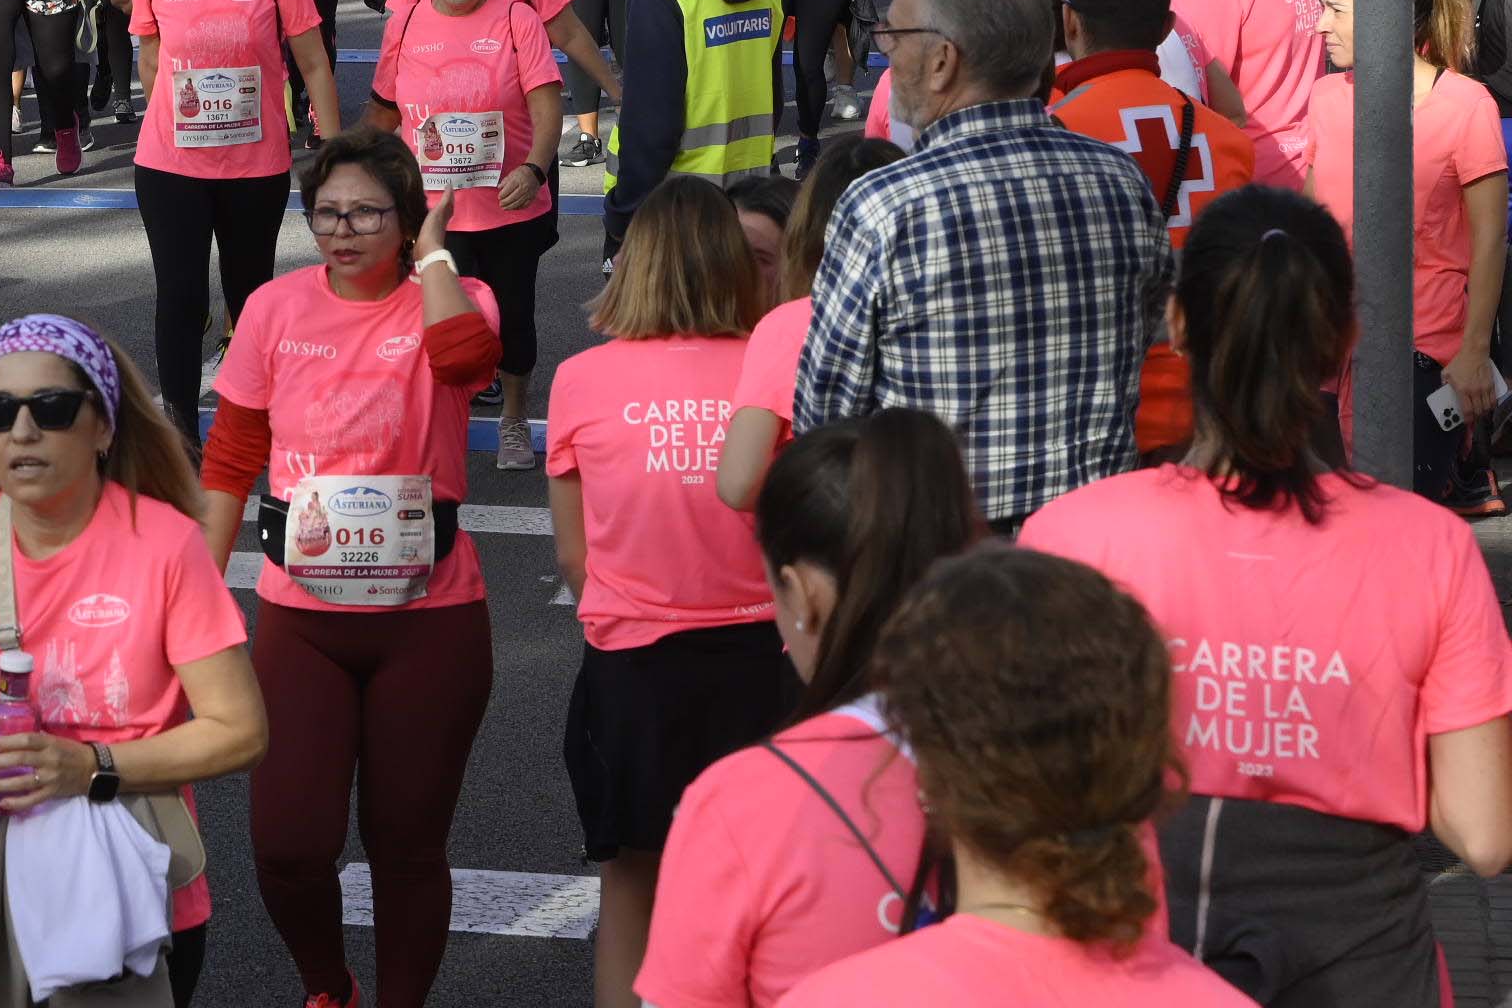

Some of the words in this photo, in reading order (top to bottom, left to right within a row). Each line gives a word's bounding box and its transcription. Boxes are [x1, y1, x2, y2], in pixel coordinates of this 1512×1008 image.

[200, 81, 234, 90] ASTURIANA
[202, 99, 232, 111] 016
[405, 103, 430, 121] TU
[182, 134, 209, 142] OYSHO
[446, 144, 475, 154] 016
[278, 340, 337, 360] OYSHO
[623, 399, 731, 425] CARRER
[650, 423, 684, 448] DE
[696, 423, 726, 446] LA
[646, 447, 720, 473] MUJE
[681, 476, 704, 484] 2023
[397, 493, 423, 501] SUMA
[333, 499, 387, 510] ASTURIANA
[335, 527, 385, 546] 016
[340, 551, 379, 563] 32226
[303, 568, 343, 577] CARRERA
[344, 568, 355, 577] DE
[357, 568, 369, 576] LA
[370, 568, 399, 577] MUJER
[1196, 676, 1247, 717] DE
[1263, 683, 1312, 720] LA
[1185, 713, 1320, 759] MUJER
